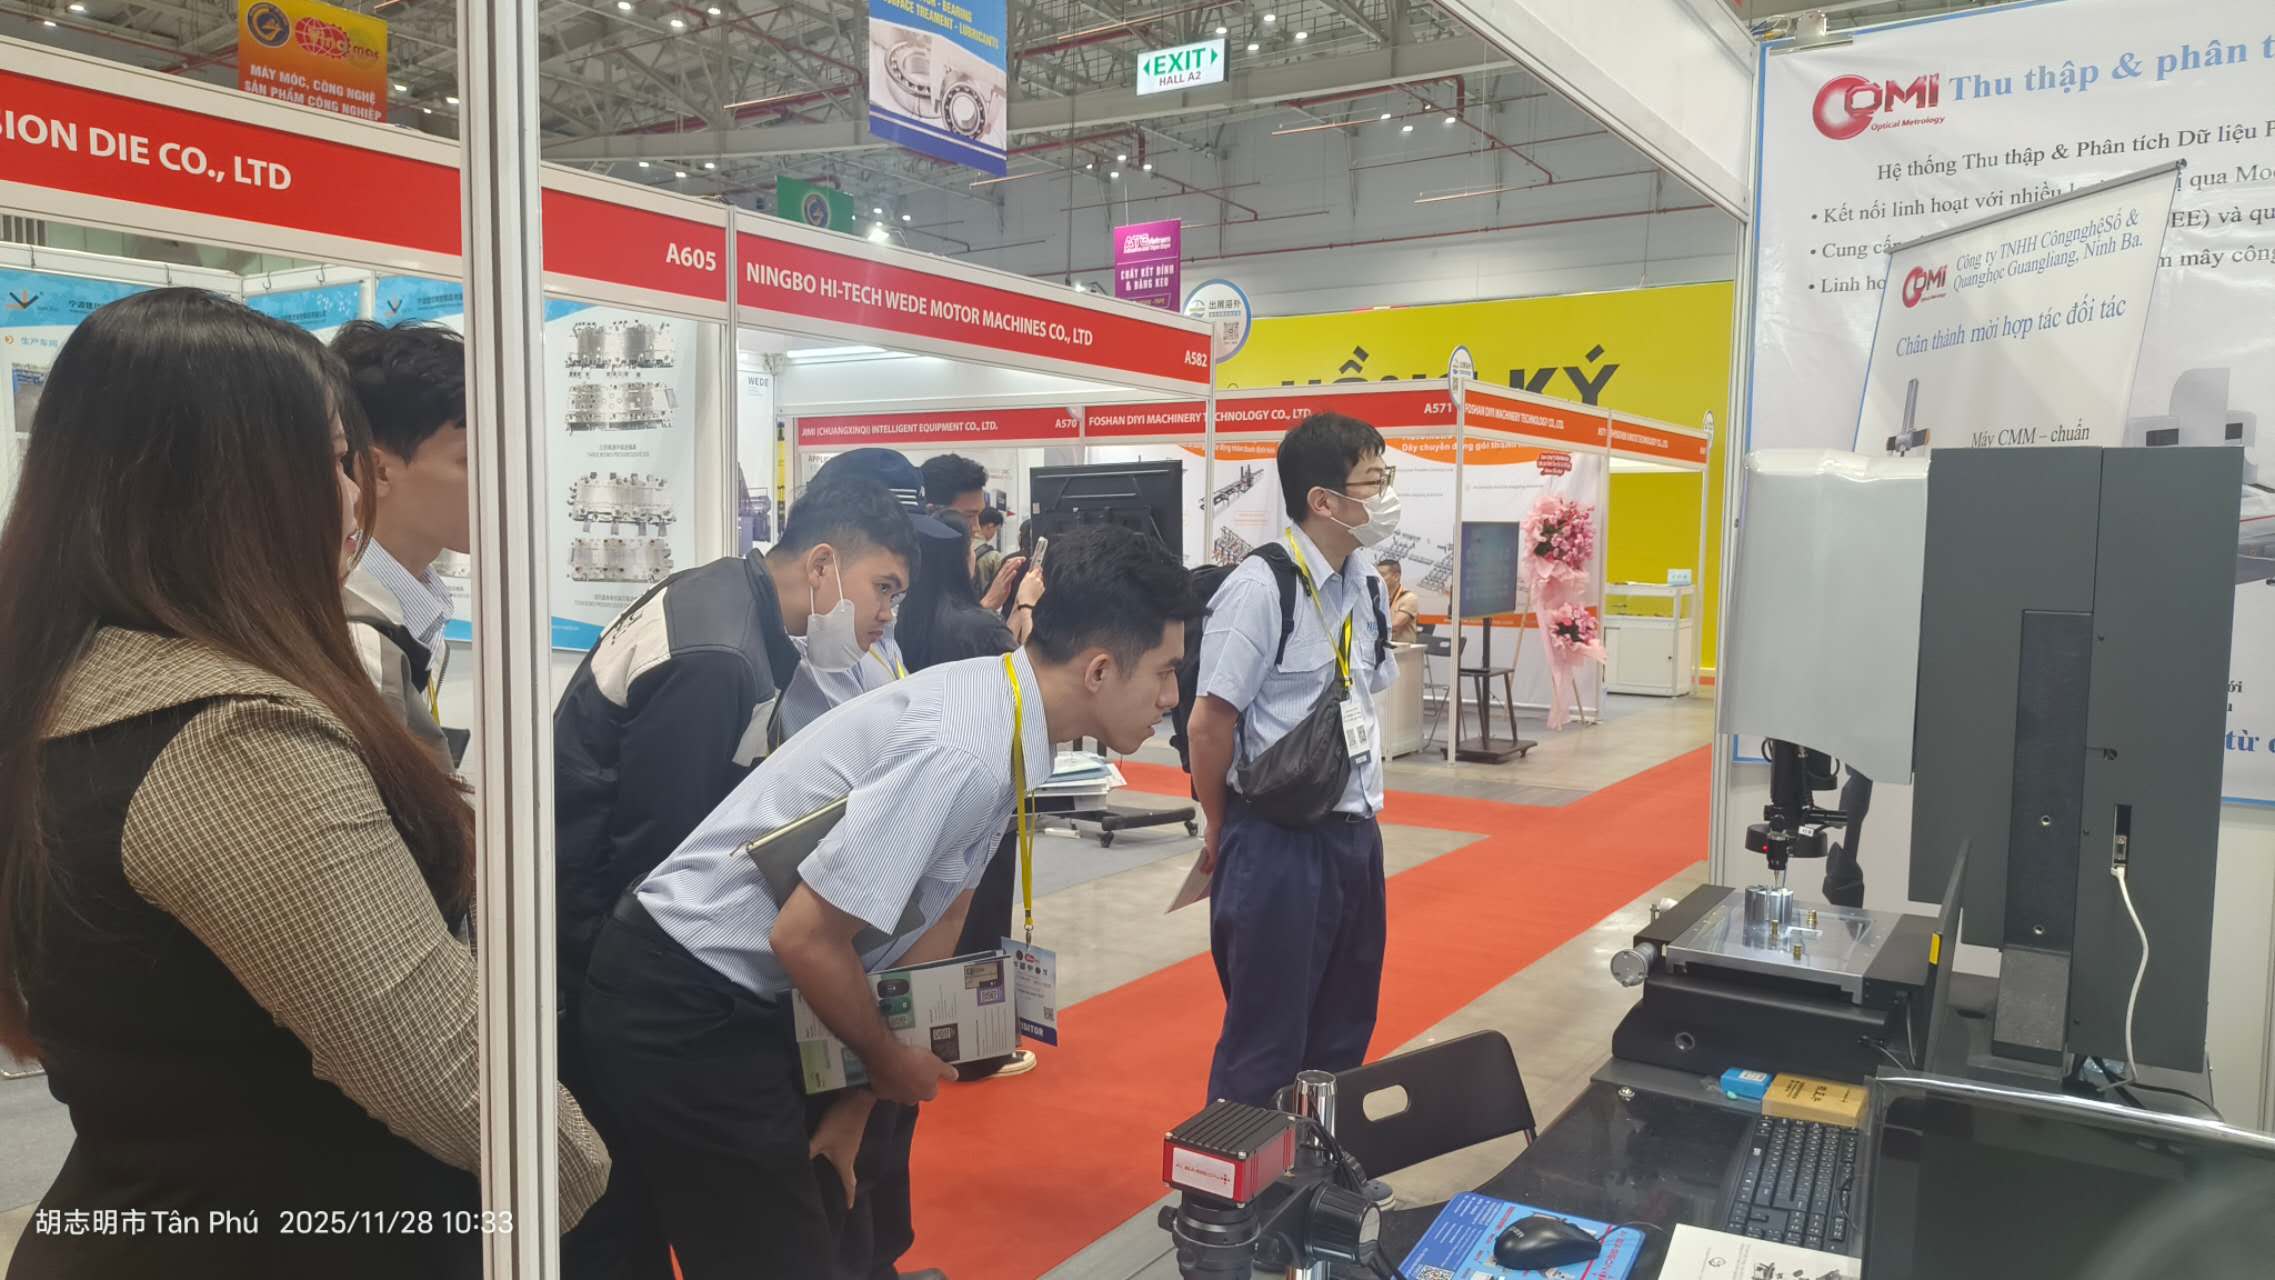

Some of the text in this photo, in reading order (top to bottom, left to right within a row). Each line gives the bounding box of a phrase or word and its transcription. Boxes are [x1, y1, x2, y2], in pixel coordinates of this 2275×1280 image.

[1153, 48, 1206, 76] EXIT
[1949, 74, 2013, 101] Thu
[2024, 60, 2099, 93] thập
[2111, 52, 2143, 80] &
[2156, 39, 2248, 81] phân
[1159, 71, 1202, 87] HALL A2
[1871, 115, 1946, 131] Optical Metrology
[0, 109, 292, 190] ION DIE CO., LTD
[1877, 164, 1901, 181] Hệ
[1907, 155, 1957, 177] thống
[1962, 152, 1998, 170] Thu
[2004, 147, 2045, 168] thập
[2051, 144, 2069, 160] &
[2076, 138, 2125, 158] Phân
[2133, 132, 2170, 151] tích
[2178, 129, 2211, 147] Dữ
[2218, 123, 2257, 144] liệu
[2189, 172, 2227, 190] qua
[1823, 202, 1854, 223] Kết
[1859, 199, 1886, 219] nối
[1892, 200, 1925, 218] linh
[1931, 197, 1969, 215] hoạt
[1975, 190, 2004, 207] với
[2218, 206, 2242, 223] và
[1956, 255, 1982, 272] Công
[1985, 249, 1998, 266] ty
[1999, 236, 2038, 260] TNHH
[2126, 208, 2140, 227] &
[2120, 231, 2143, 251] Ba.
[665, 242, 717, 272] A605
[1822, 242, 1868, 260] Cung
[2180, 248, 2224, 269] mây
[1821, 277, 1859, 293] Linh
[746, 262, 1093, 346] NINGBO HI-TECH WEDE MOTOR MACHINES CO., LTD
[1896, 295, 2126, 357] Chân thành mời hợp tác đối tác
[1184, 349, 1209, 368] A582
[748, 376, 769, 387] WEDE
[1089, 415, 1126, 427] FOSHAN
[1127, 414, 1145, 425] DIYI
[1147, 412, 1200, 425] MACHINERY
[1200, 409, 1269, 423] TCHNOLOGY
[1271, 409, 1291, 420] CO.,
[1424, 403, 1452, 415] A571
[871, 423, 918, 435] INTELLIGENT
[919, 421, 964, 433] EQUIPMENT
[1055, 418, 1077, 429] A570
[1998, 427, 2037, 446] CMM
[2050, 417, 2090, 442] chuẩn
